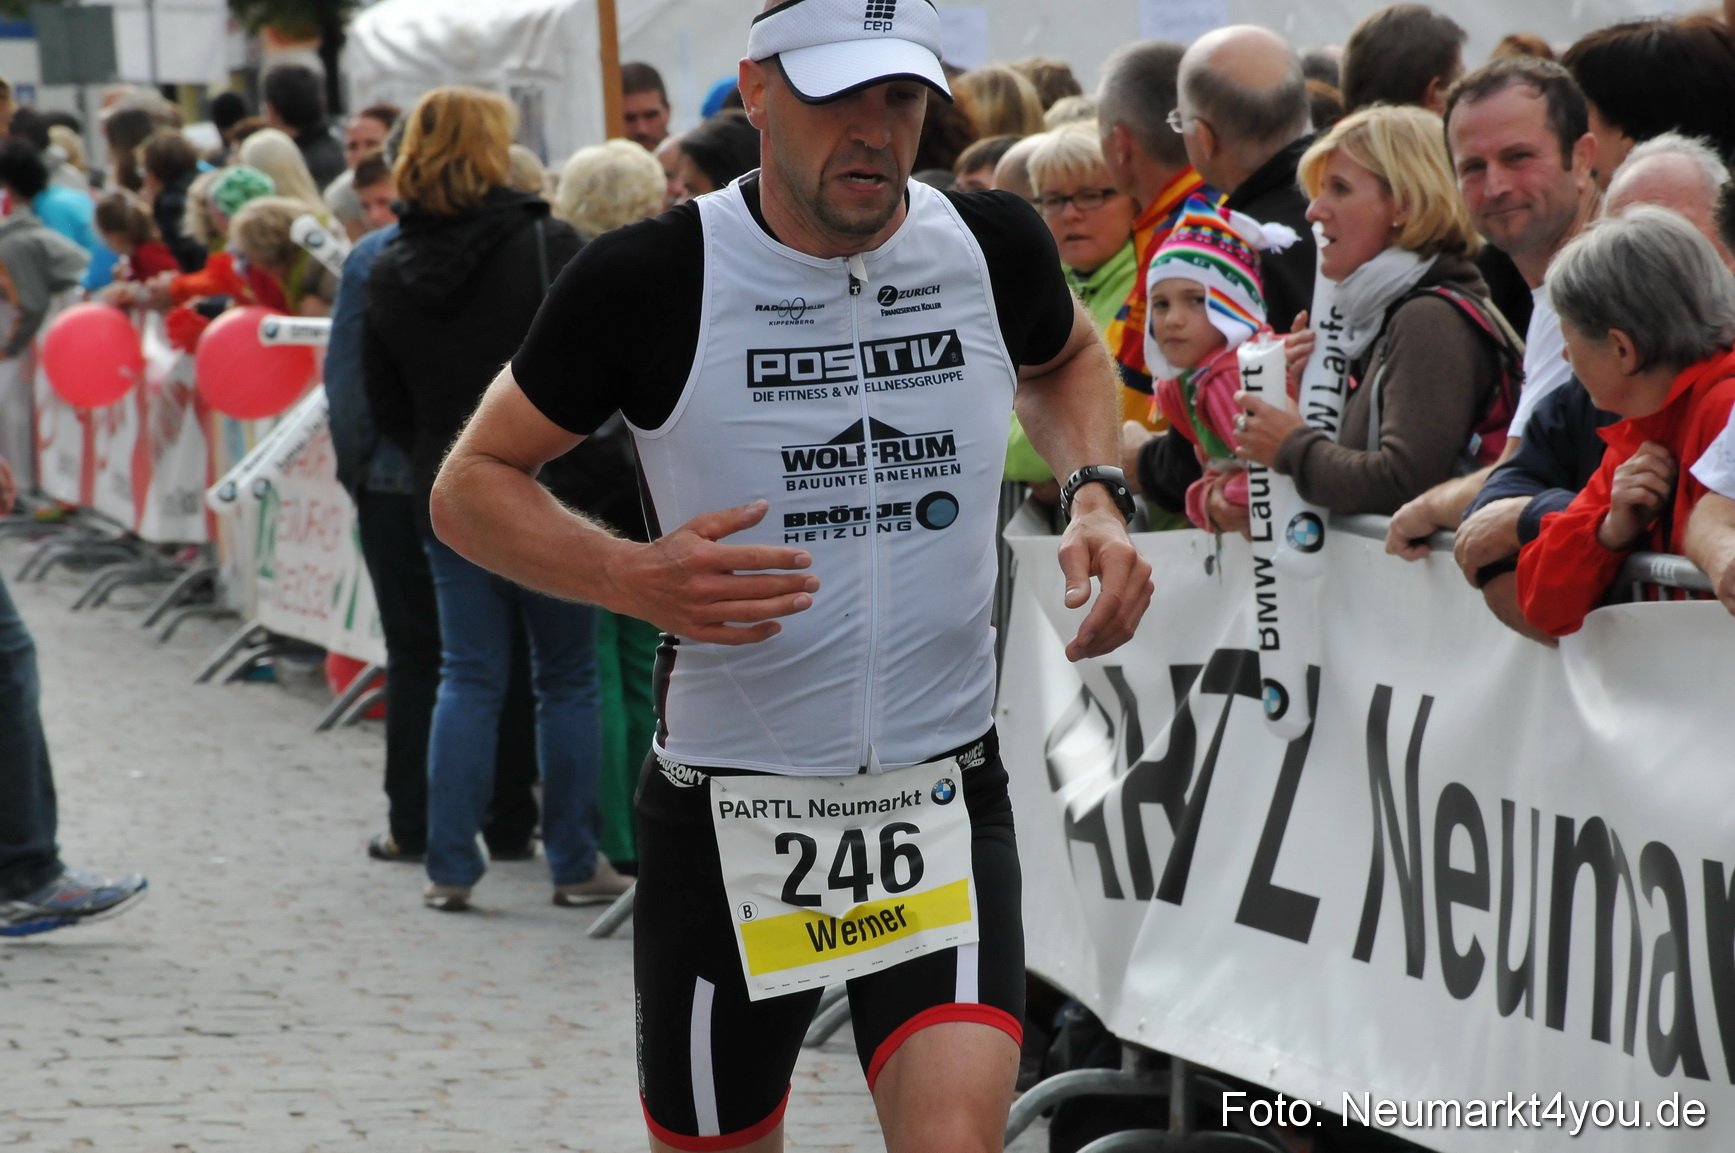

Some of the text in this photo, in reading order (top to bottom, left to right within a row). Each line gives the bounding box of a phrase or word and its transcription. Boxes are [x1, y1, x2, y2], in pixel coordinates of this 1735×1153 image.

[863, 20, 893, 33] cep
[898, 284, 941, 300] ZURICH
[768, 319, 815, 327] KIPFENBERG
[752, 334, 952, 384] POSITIV
[752, 370, 964, 403] DIE FITNESS & WELLNESSGRUPPE
[781, 434, 957, 473] WOLFRUM
[786, 463, 962, 492] BAUUNTERNEHMEN
[783, 501, 912, 528] BRÖTJE
[784, 520, 912, 544] HEIZUNG
[1252, 556, 1280, 651] BMW
[719, 789, 922, 819] PARTL Neumarkt
[774, 821, 925, 907] 246
[742, 904, 753, 920] B
[805, 902, 908, 953] Werner
